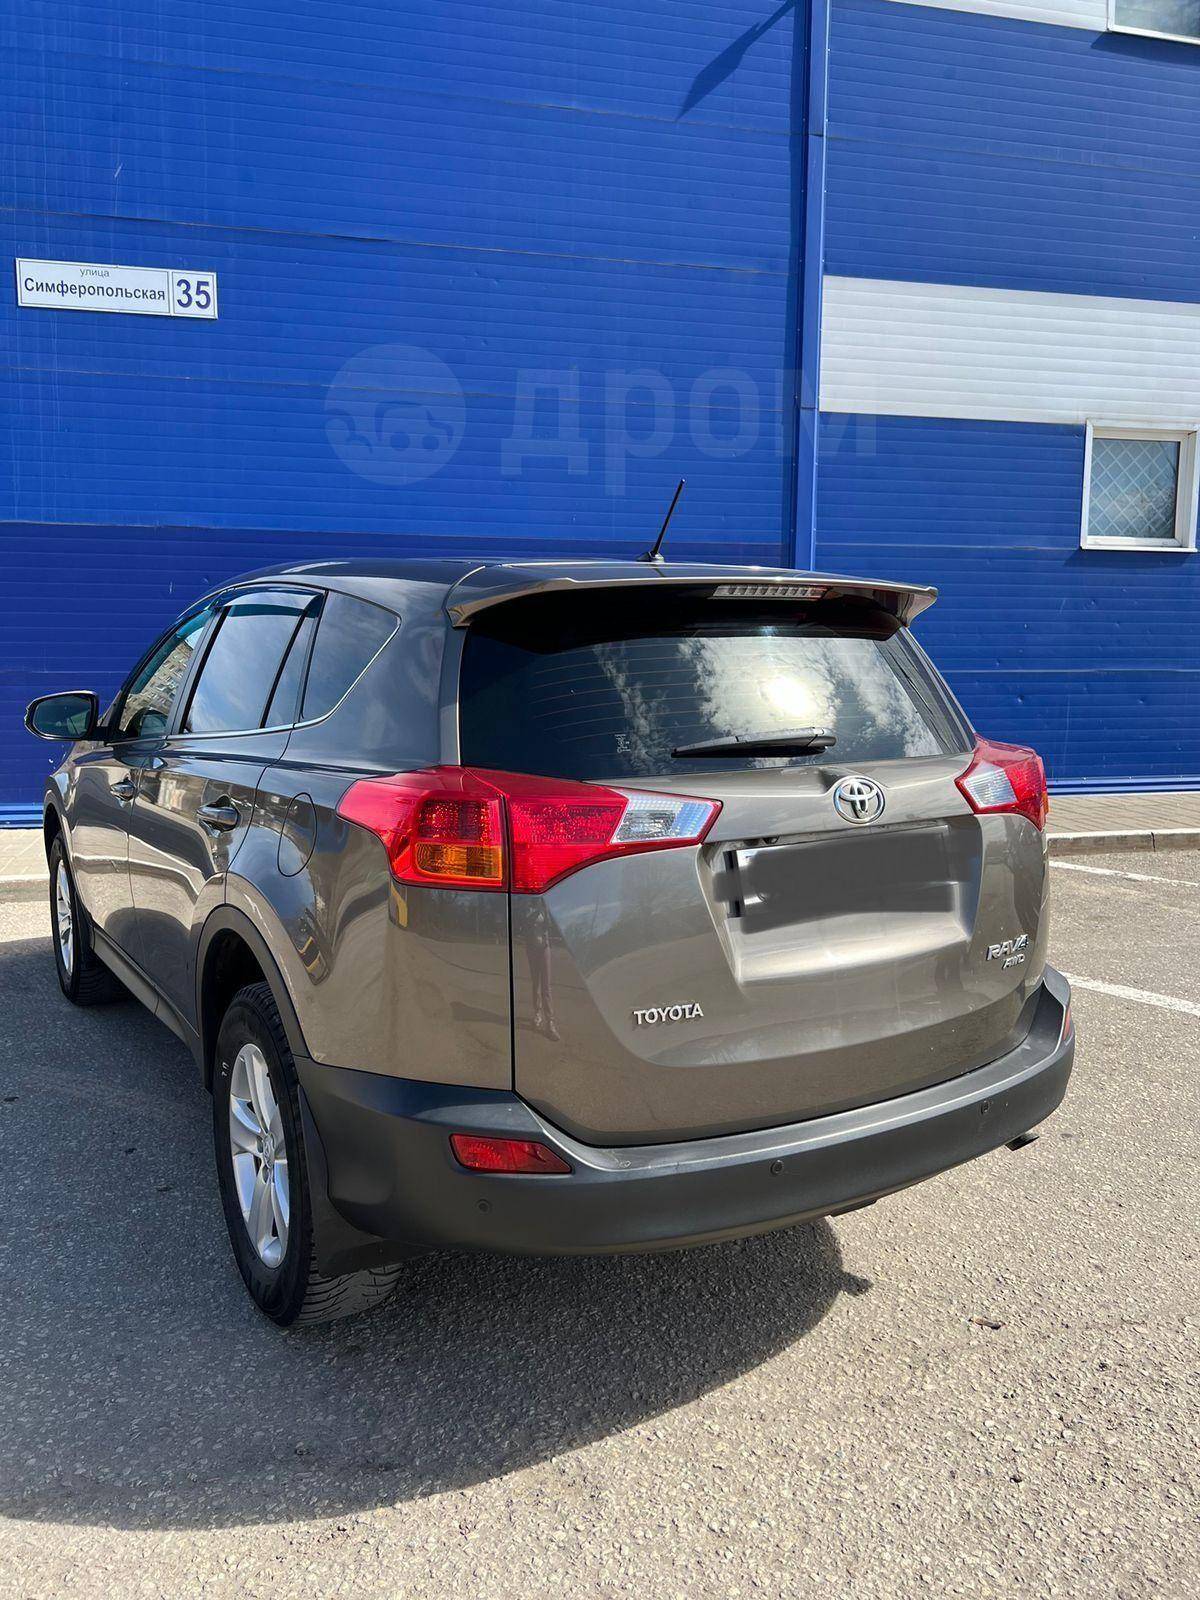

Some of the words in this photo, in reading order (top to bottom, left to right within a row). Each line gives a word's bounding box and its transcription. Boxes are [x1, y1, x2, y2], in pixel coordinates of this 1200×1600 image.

[79, 267, 110, 278] улица
[24, 277, 166, 301] Симферопольская
[176, 278, 211, 310] 35
[986, 934, 1029, 961] RAV4
[1002, 953, 1026, 970] AWD
[633, 1002, 705, 1025] TOYOTA
